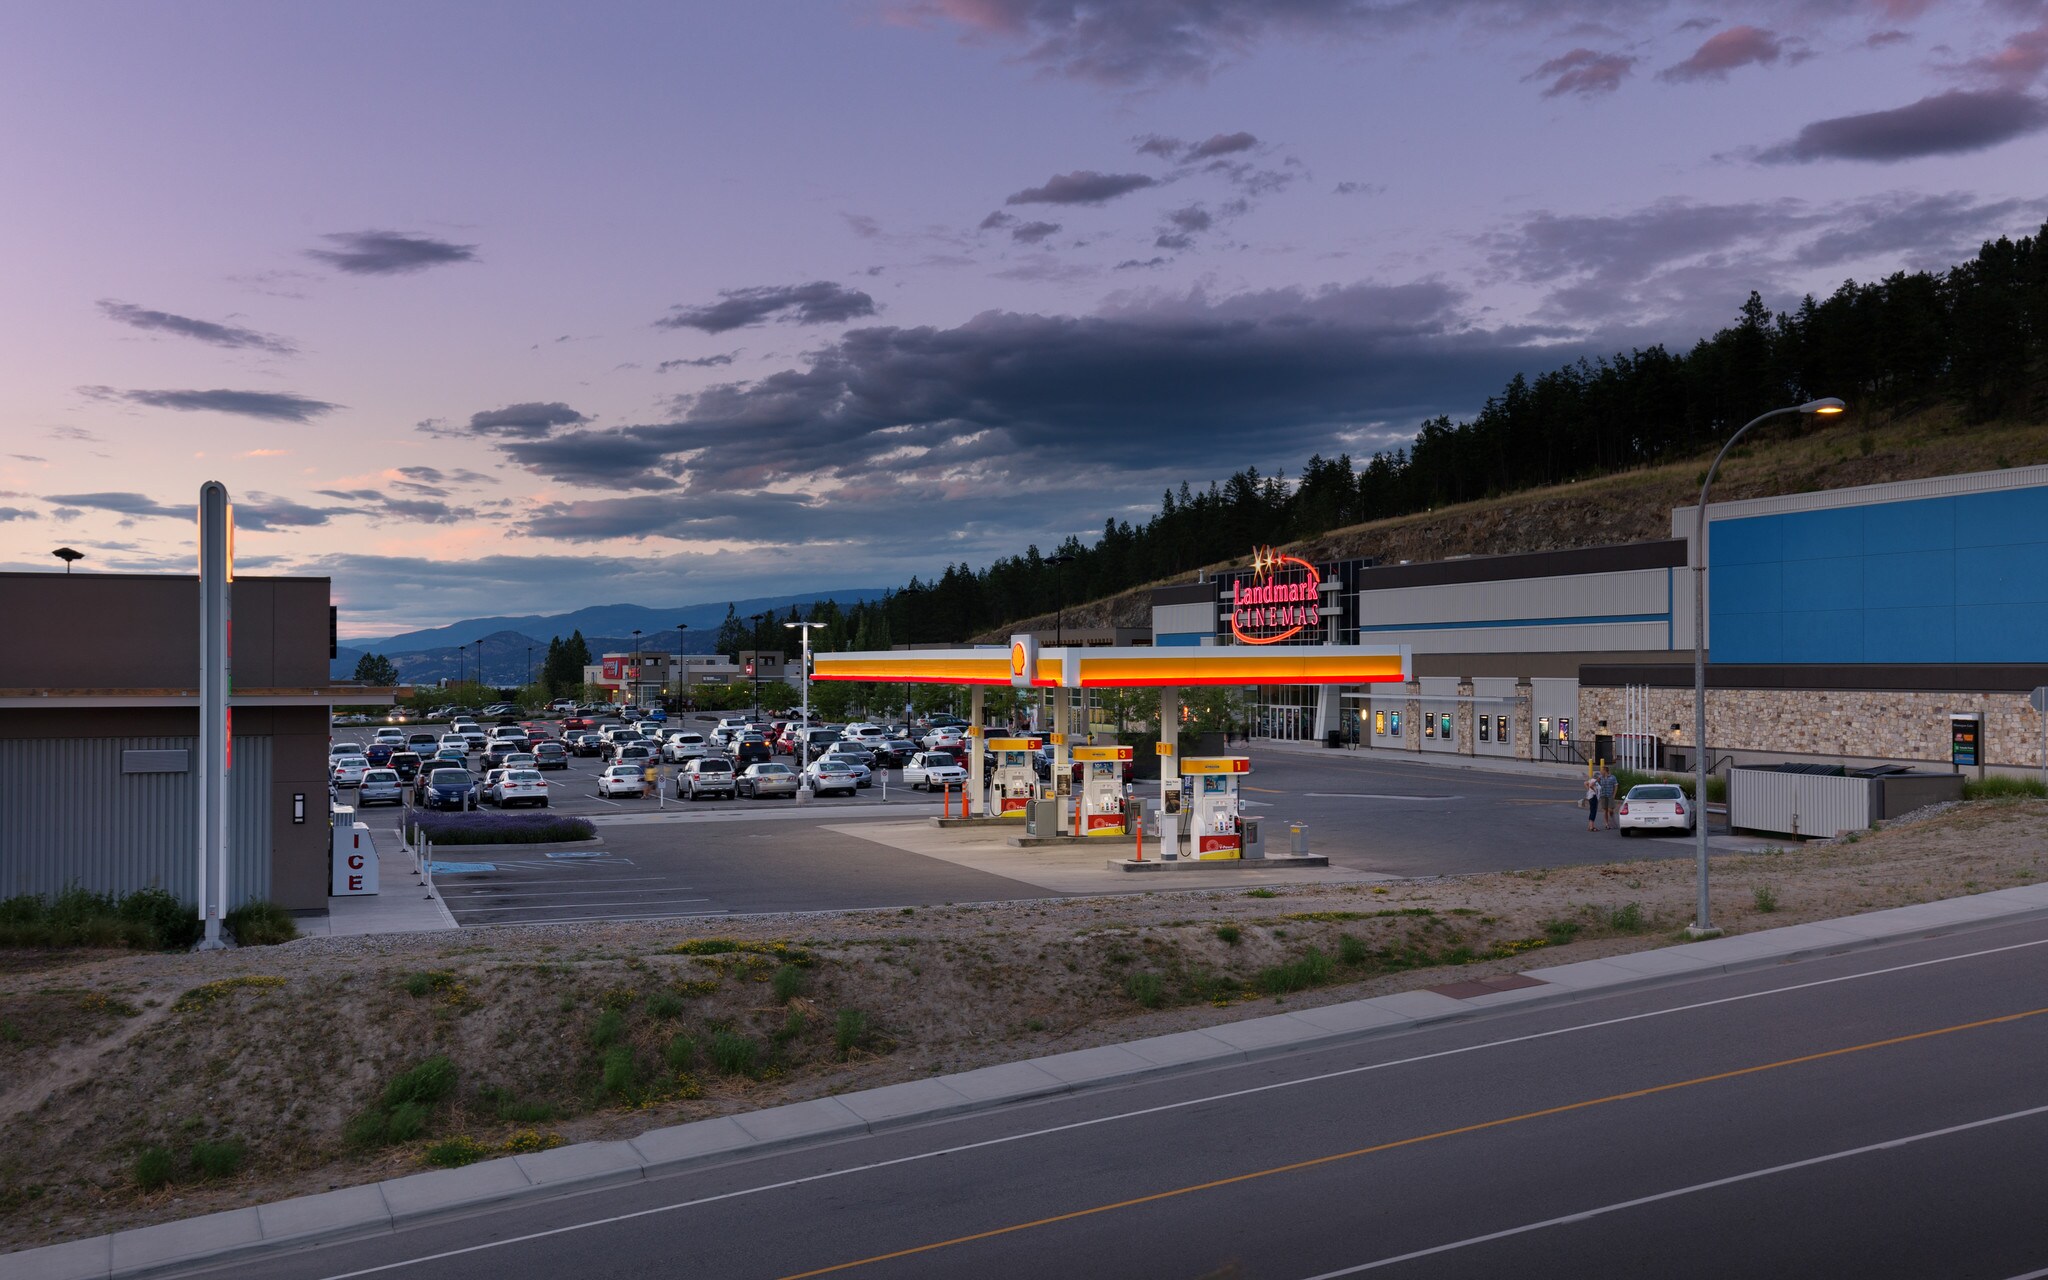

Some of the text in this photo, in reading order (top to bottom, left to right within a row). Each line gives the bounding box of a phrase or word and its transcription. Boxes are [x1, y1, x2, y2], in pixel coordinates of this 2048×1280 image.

[1234, 573, 1319, 606] Landmark
[1234, 603, 1319, 629] CINEMAS
[1030, 741, 1035, 749] 5
[1120, 750, 1126, 758] 3
[1236, 761, 1241, 770] 1
[347, 834, 364, 891] ICE
